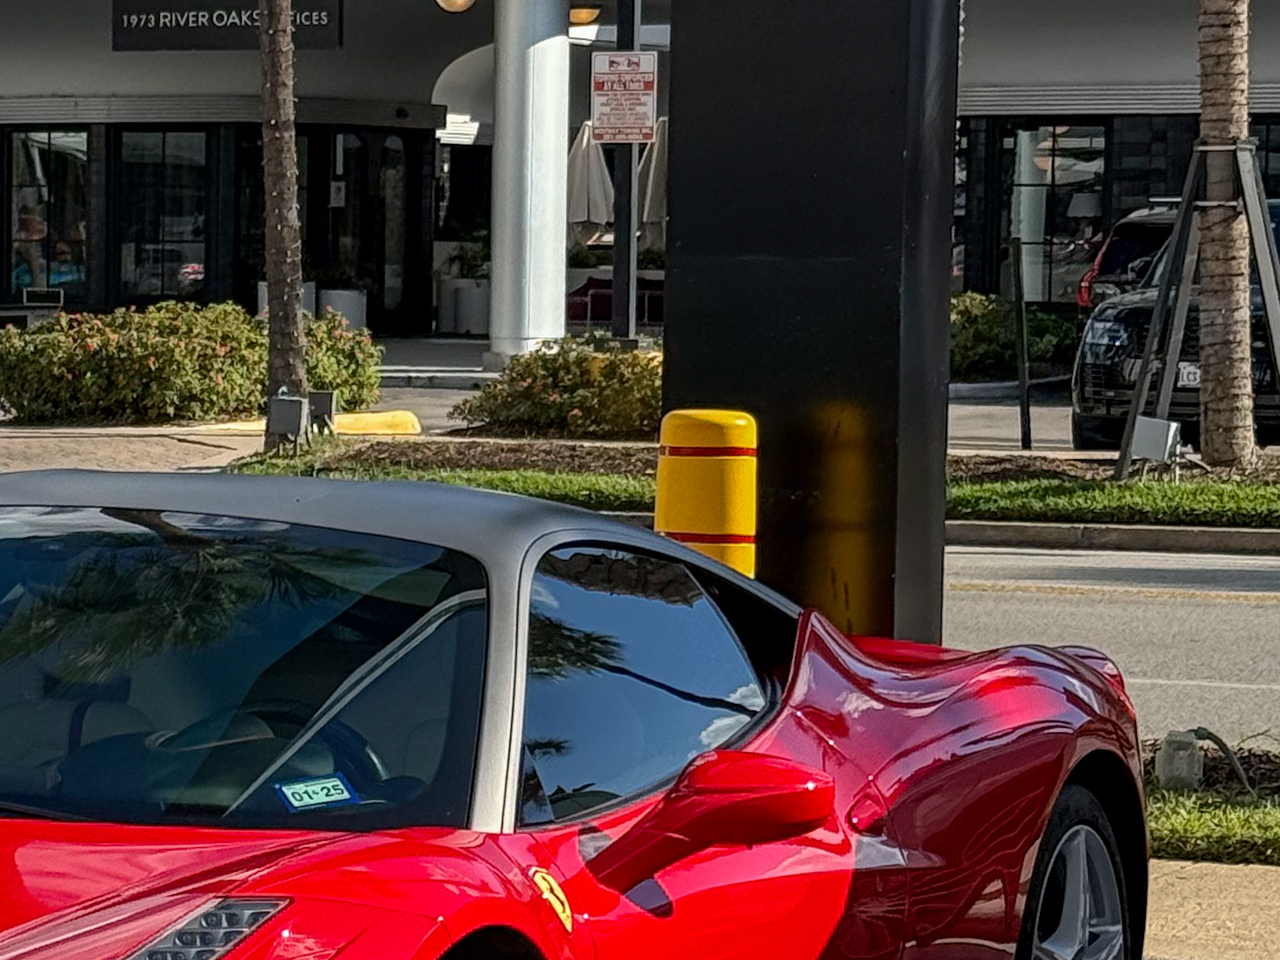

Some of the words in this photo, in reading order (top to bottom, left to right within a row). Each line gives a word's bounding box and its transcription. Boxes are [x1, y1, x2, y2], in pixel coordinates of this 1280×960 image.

[122, 14, 155, 28] 1973
[159, 12, 208, 27] RIVER
[213, 10, 261, 26] OAKS
